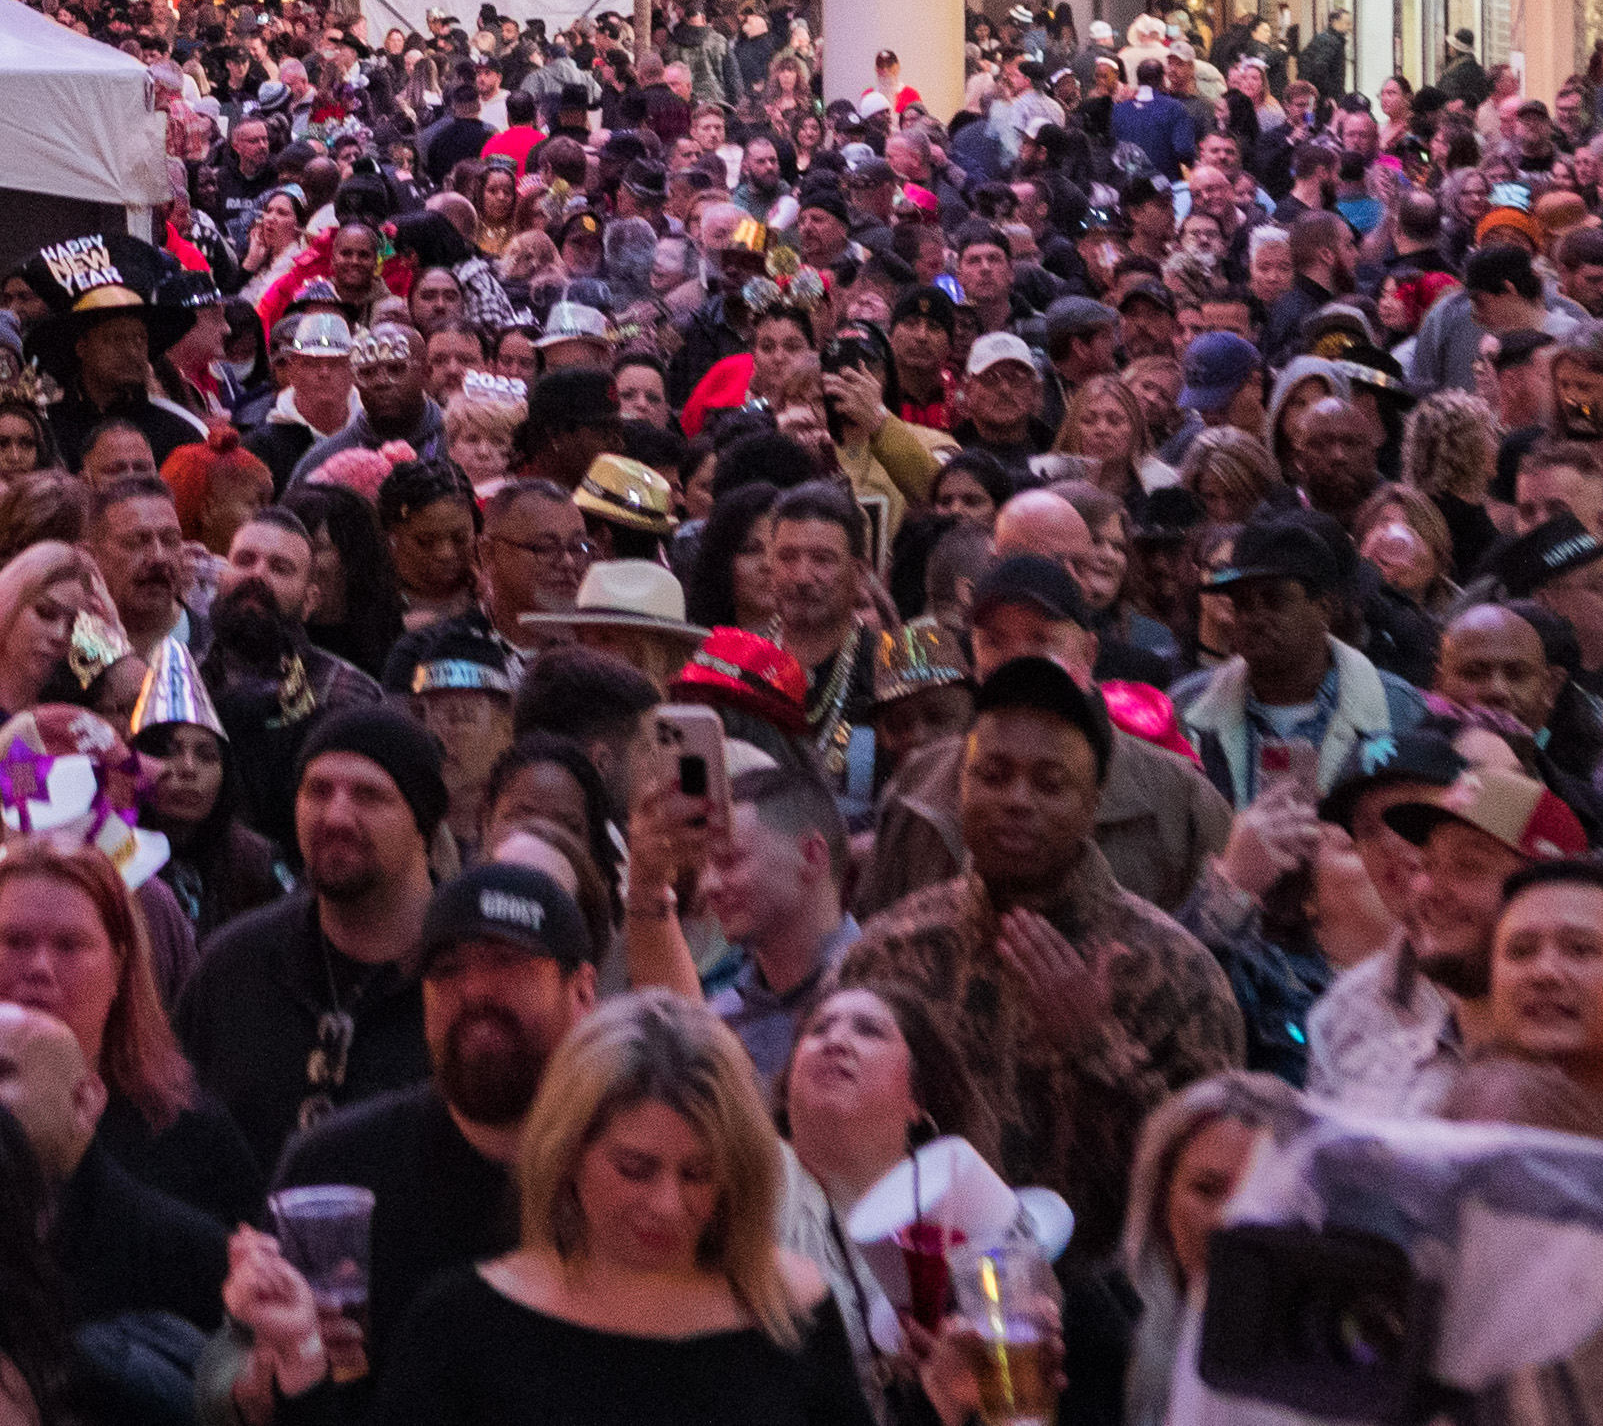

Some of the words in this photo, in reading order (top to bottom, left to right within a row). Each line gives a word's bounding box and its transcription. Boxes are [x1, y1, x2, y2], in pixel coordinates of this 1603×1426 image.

[40, 233, 104, 263] HAPPY
[46, 247, 112, 284] NEW
[57, 265, 124, 298] YEAR
